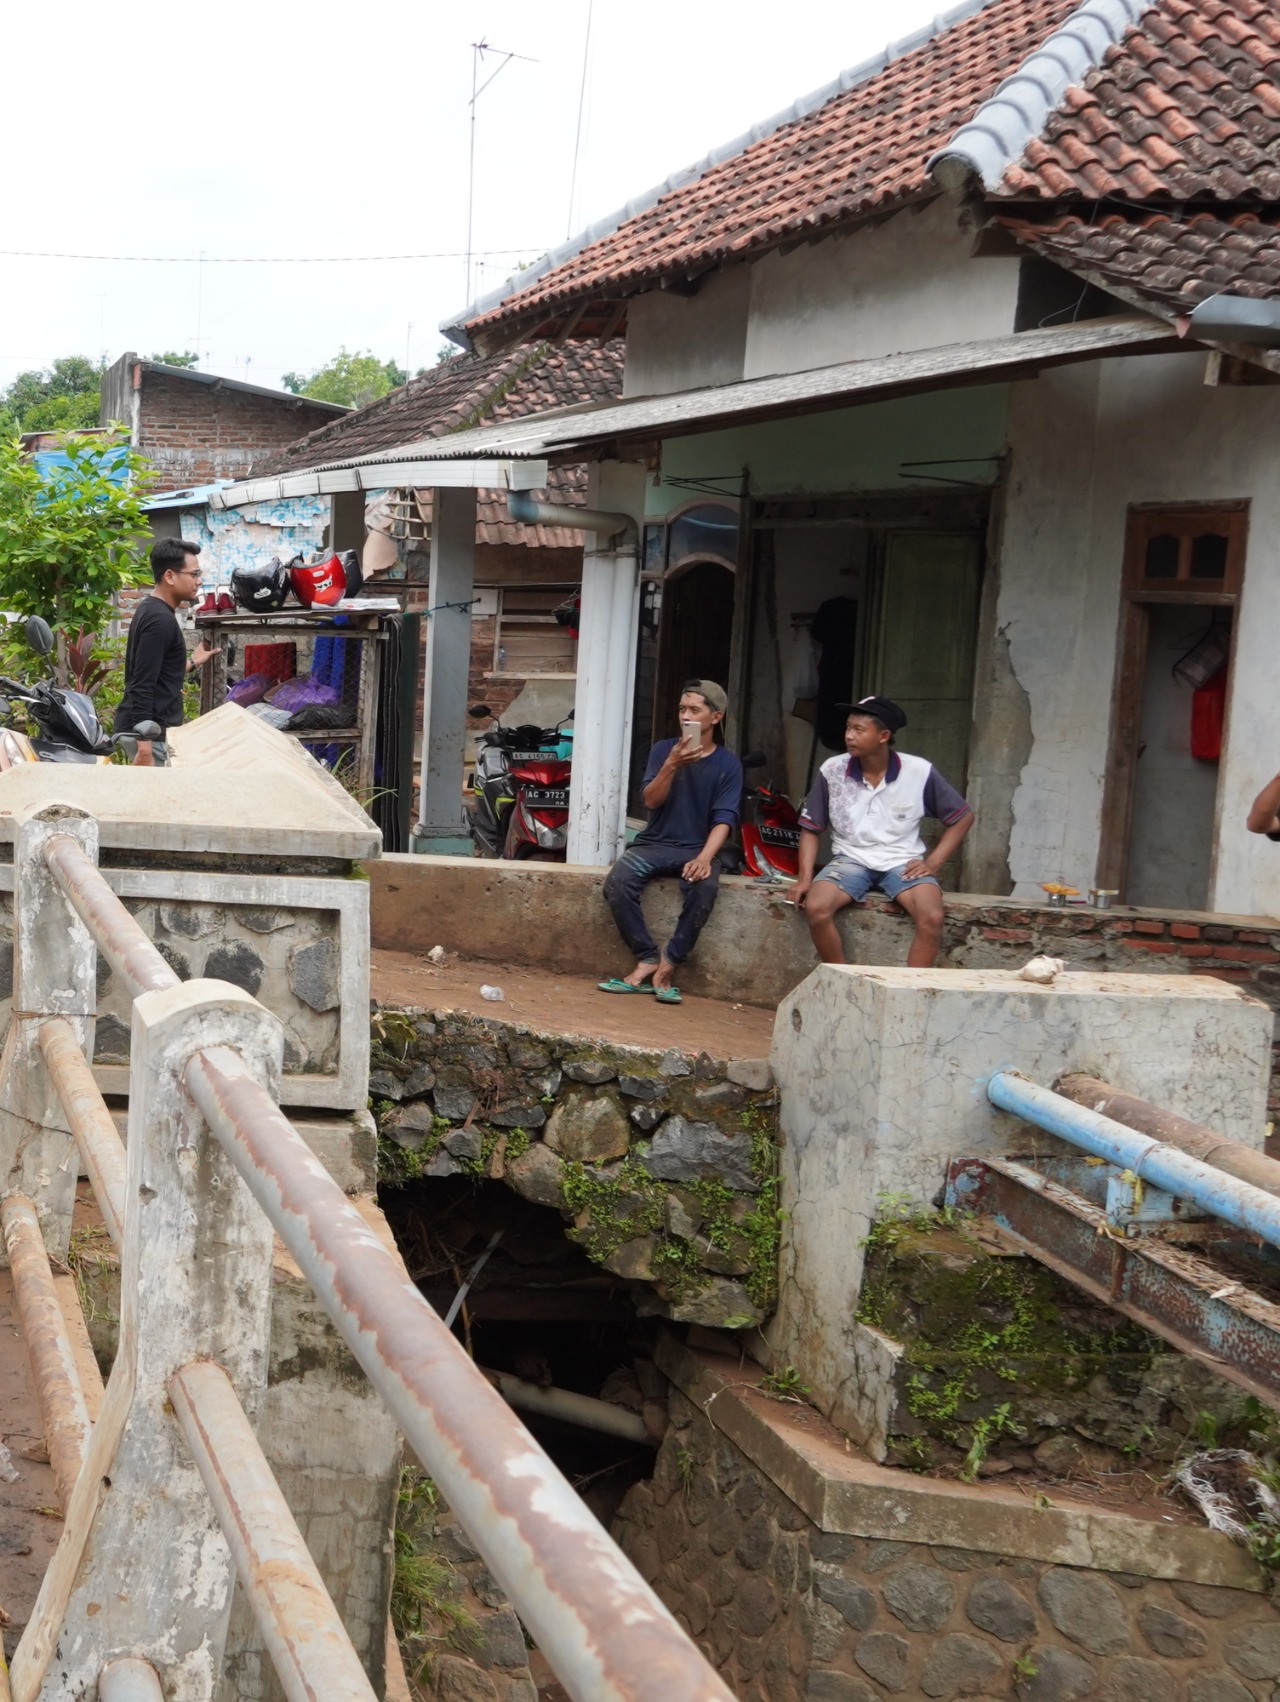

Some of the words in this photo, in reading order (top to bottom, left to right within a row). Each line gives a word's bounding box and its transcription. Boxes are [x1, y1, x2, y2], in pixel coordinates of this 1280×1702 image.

[545, 791, 565, 799] 3723
[761, 827, 772, 835] AG
[773, 829, 794, 839] 2116
